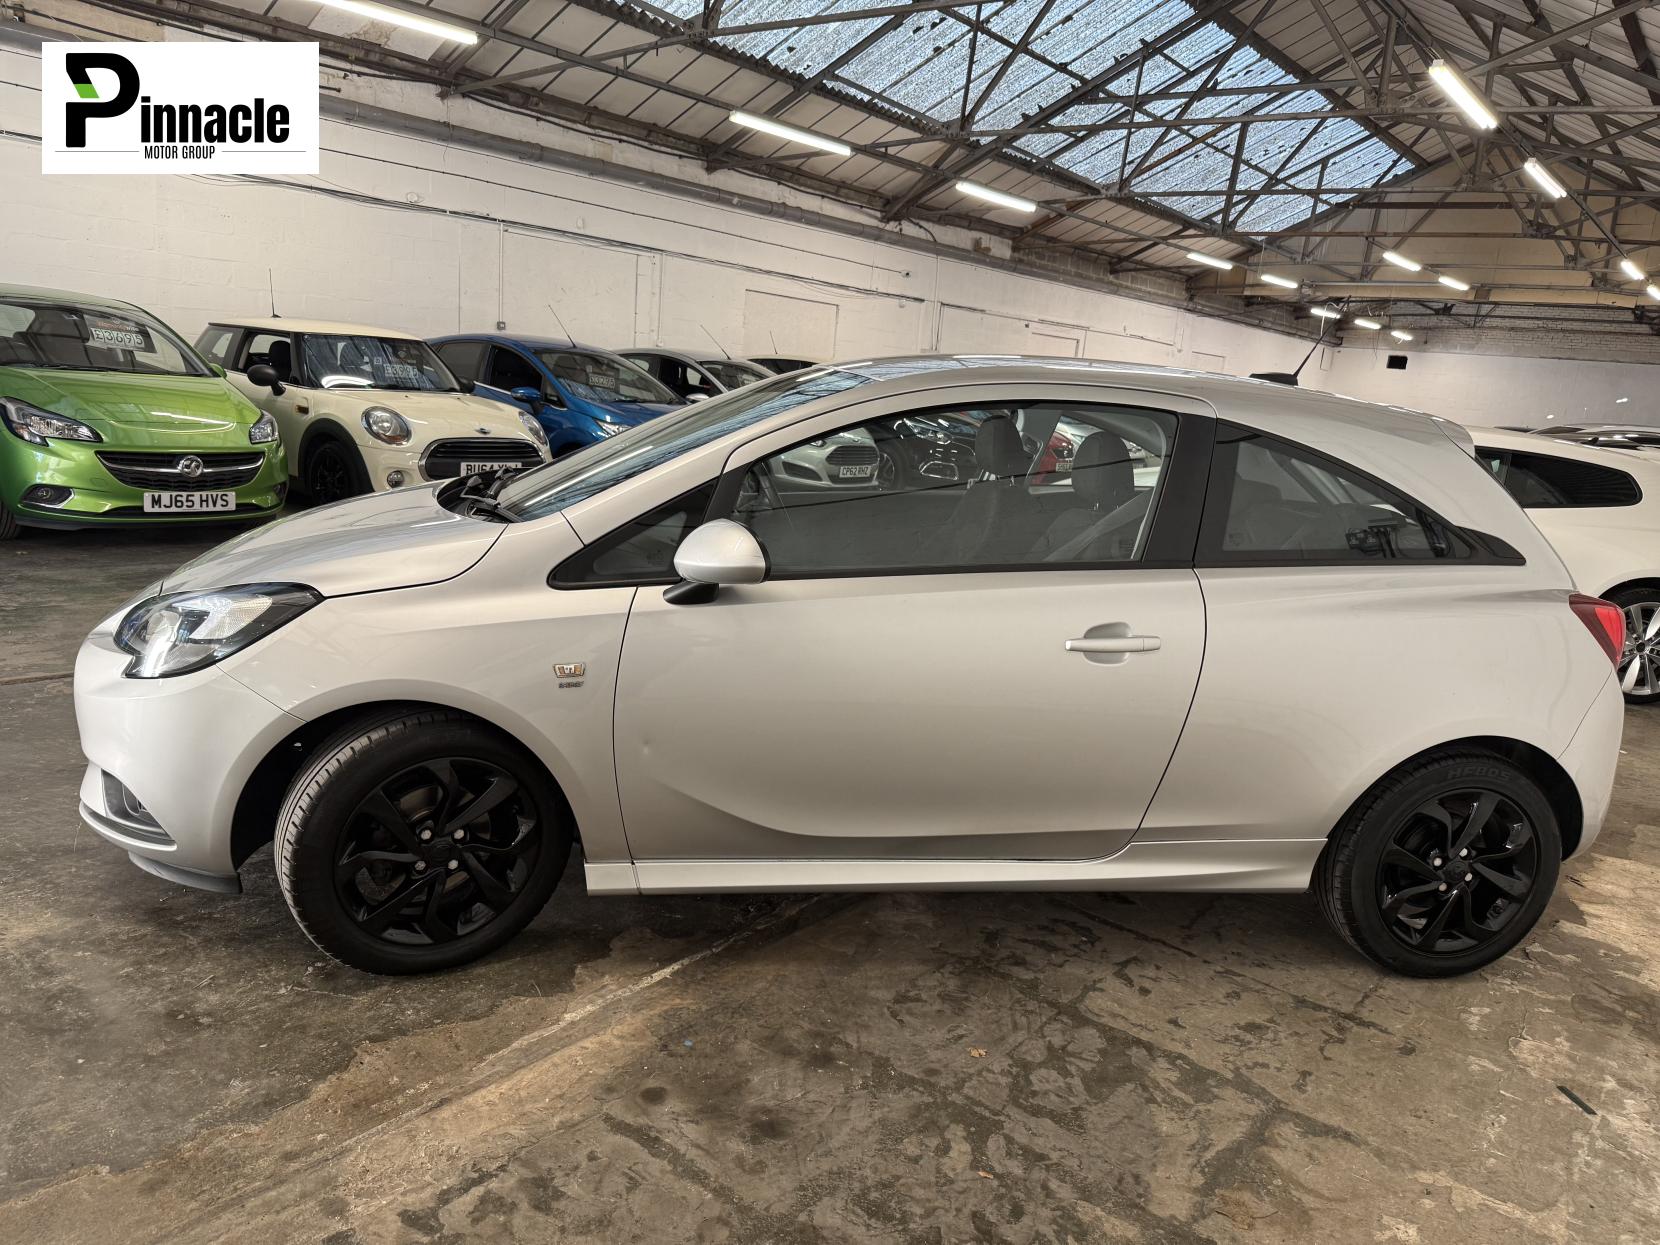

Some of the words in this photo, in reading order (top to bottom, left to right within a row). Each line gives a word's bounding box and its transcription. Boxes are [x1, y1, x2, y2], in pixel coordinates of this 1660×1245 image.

[93, 329, 143, 345] £3695
[151, 494, 195, 509] MJ65
[199, 493, 229, 508] HVS
